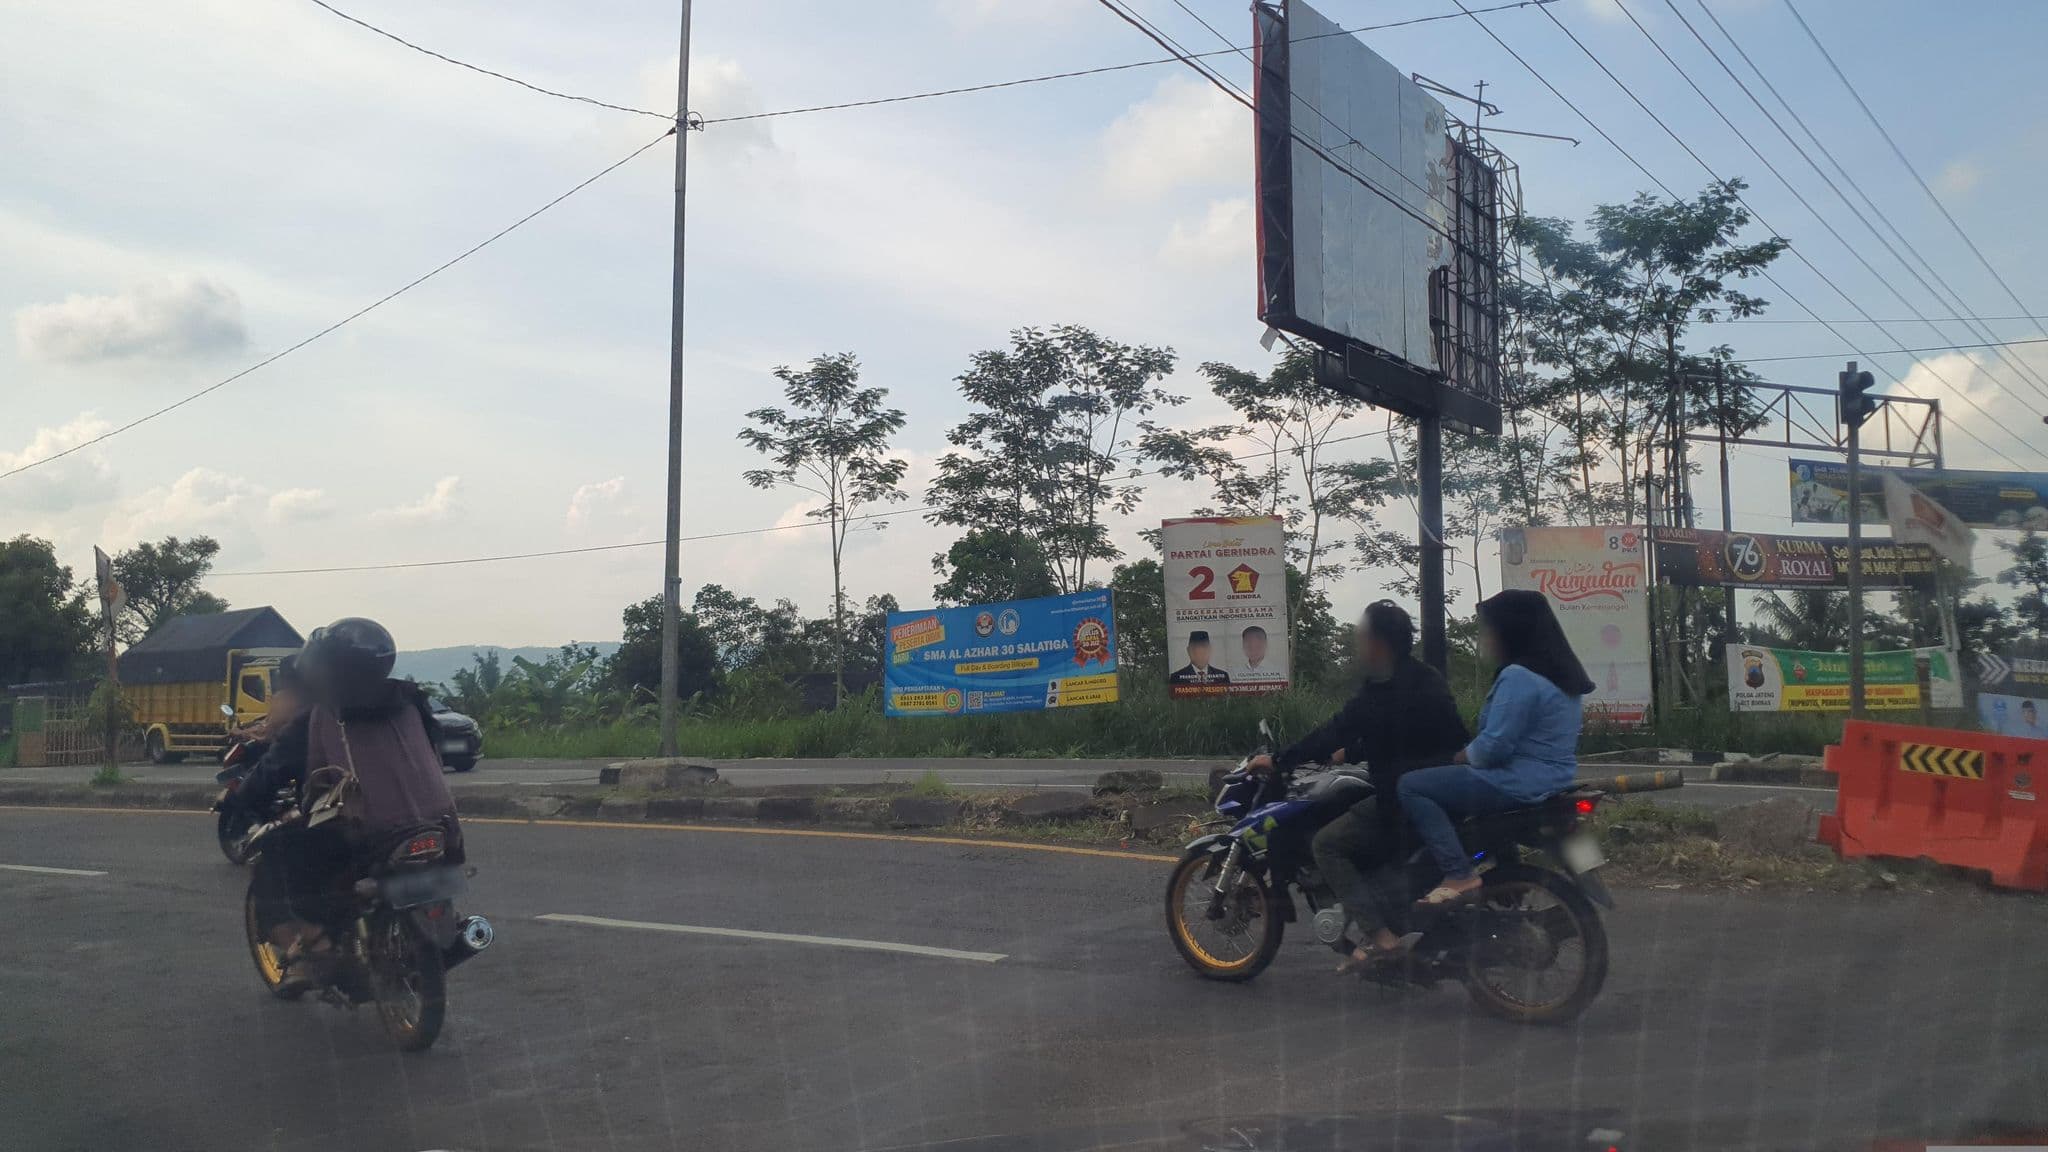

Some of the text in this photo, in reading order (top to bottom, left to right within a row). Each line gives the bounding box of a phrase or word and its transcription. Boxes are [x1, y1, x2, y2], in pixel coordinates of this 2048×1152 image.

[1609, 536, 1619, 550] 8
[1776, 540, 1826, 554] KURMA
[1170, 547, 1277, 560] PARTAI GERINDRA
[1733, 537, 1758, 573] 76
[1781, 560, 1831, 576] ROYAL
[1188, 565, 1216, 601] 2
[1530, 561, 1642, 599] Ramadan
[1559, 603, 1581, 611] Bulan
[924, 639, 1069, 660] SMA AL AZHAR 30 SALATIGA
